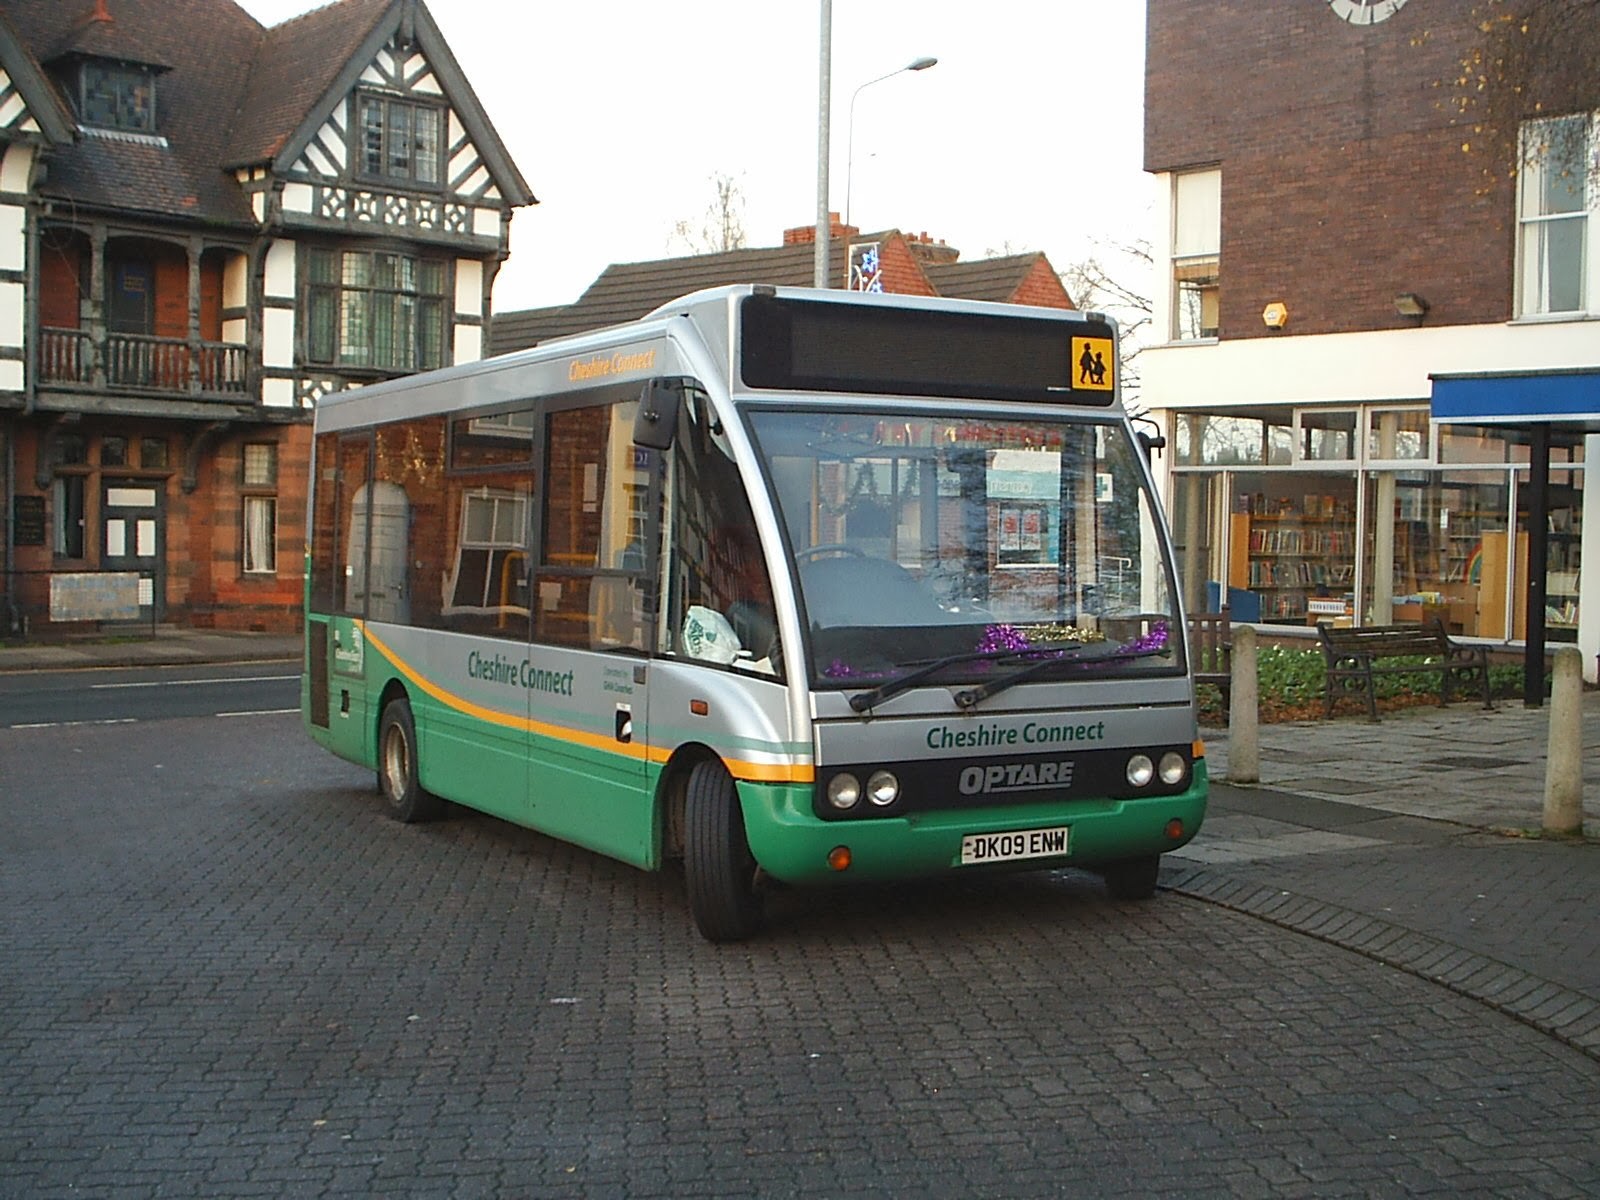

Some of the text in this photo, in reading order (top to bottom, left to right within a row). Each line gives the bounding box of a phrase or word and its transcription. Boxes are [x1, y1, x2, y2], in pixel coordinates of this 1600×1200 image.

[569, 348, 656, 381] Cheshire Connect
[468, 651, 574, 696] Cheshire Connect
[927, 721, 1105, 749] Cheshire Connect
[958, 761, 1075, 795] OPTARE
[974, 830, 1065, 859] DK09 ENW
